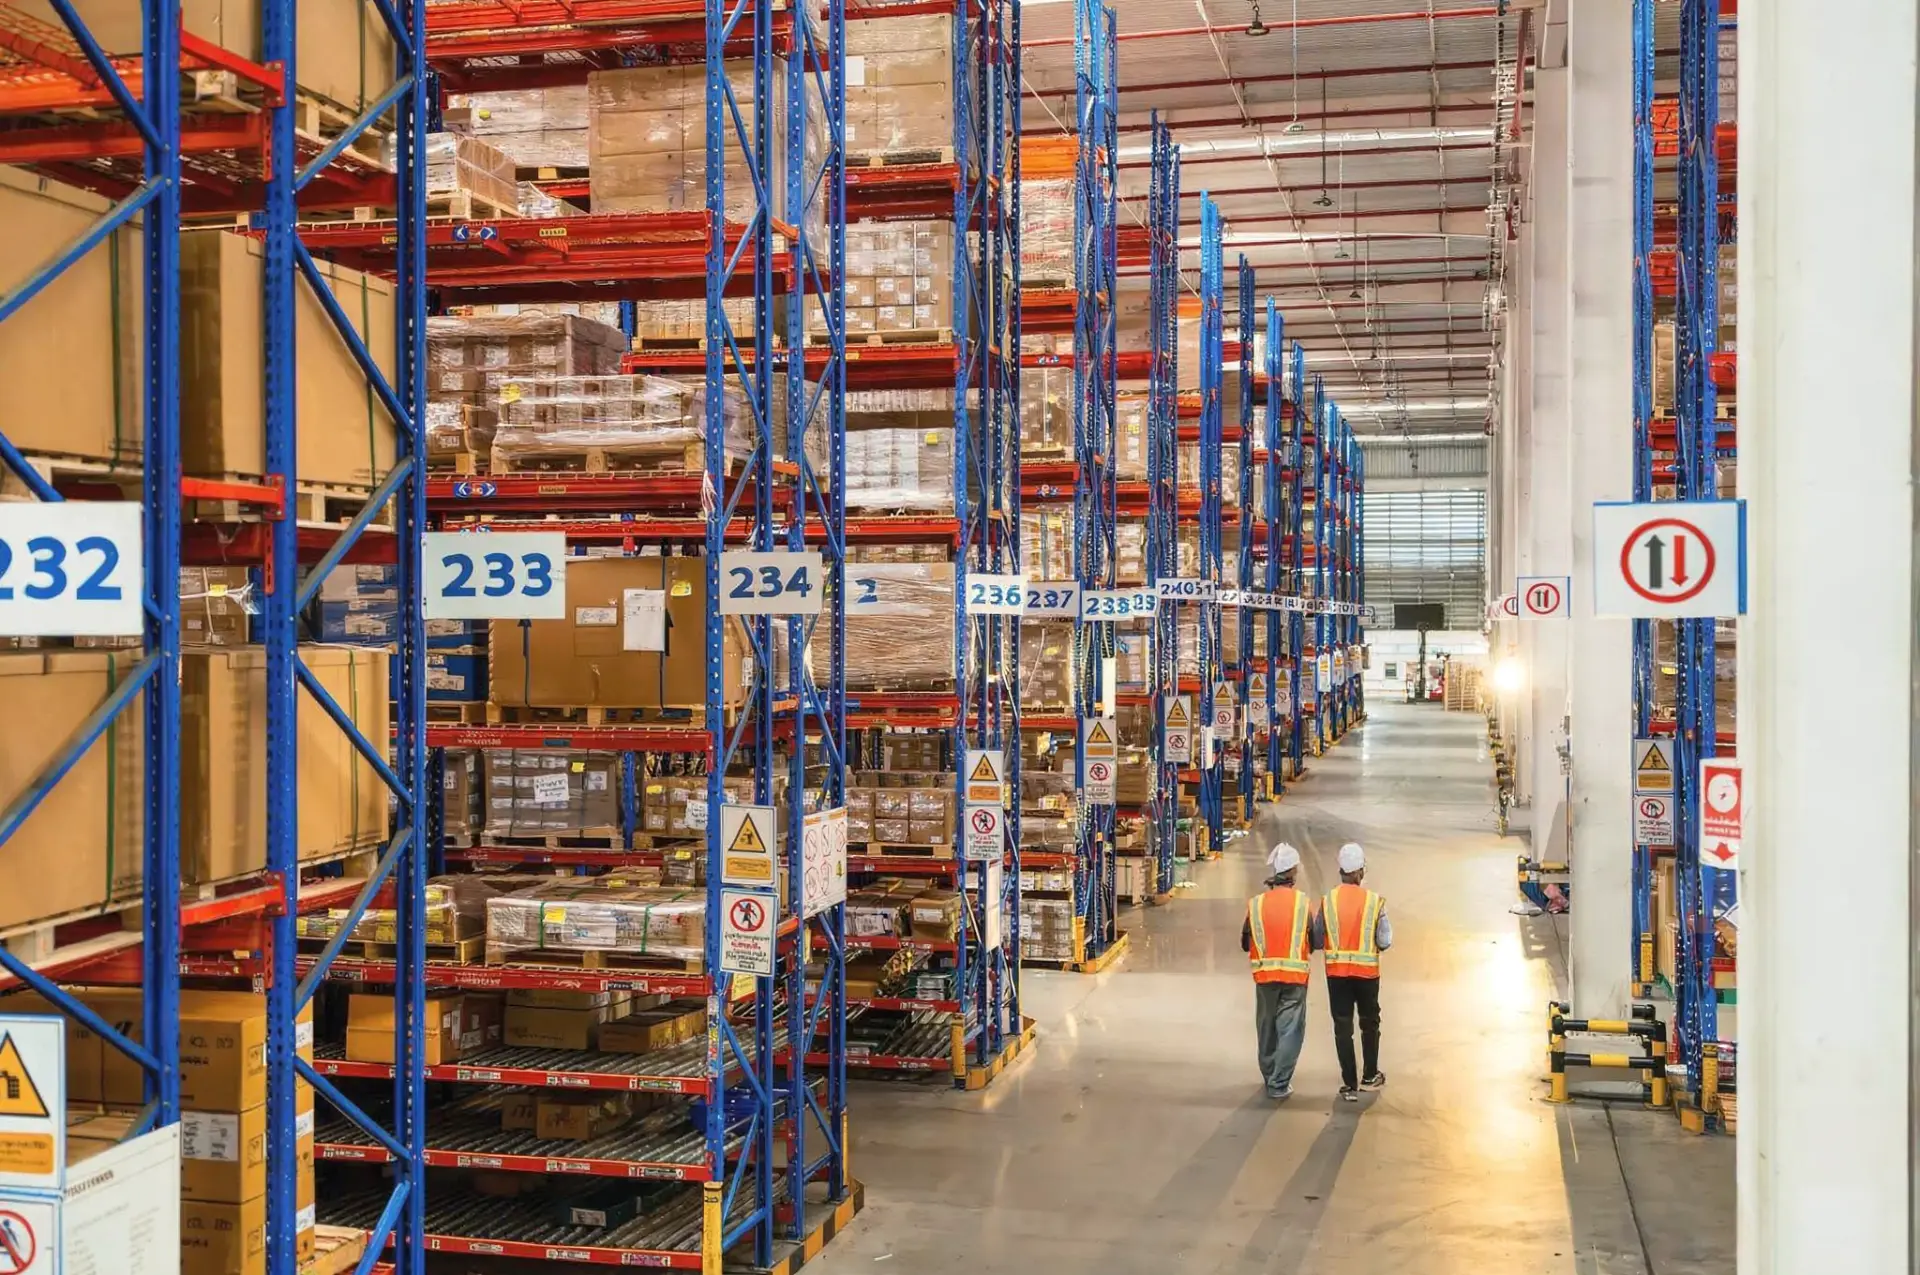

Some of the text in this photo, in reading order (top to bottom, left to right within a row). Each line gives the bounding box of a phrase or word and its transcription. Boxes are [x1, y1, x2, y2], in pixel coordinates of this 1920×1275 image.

[441, 552, 553, 597] 233
[729, 566, 814, 598] 234
[971, 584, 1021, 606] 236
